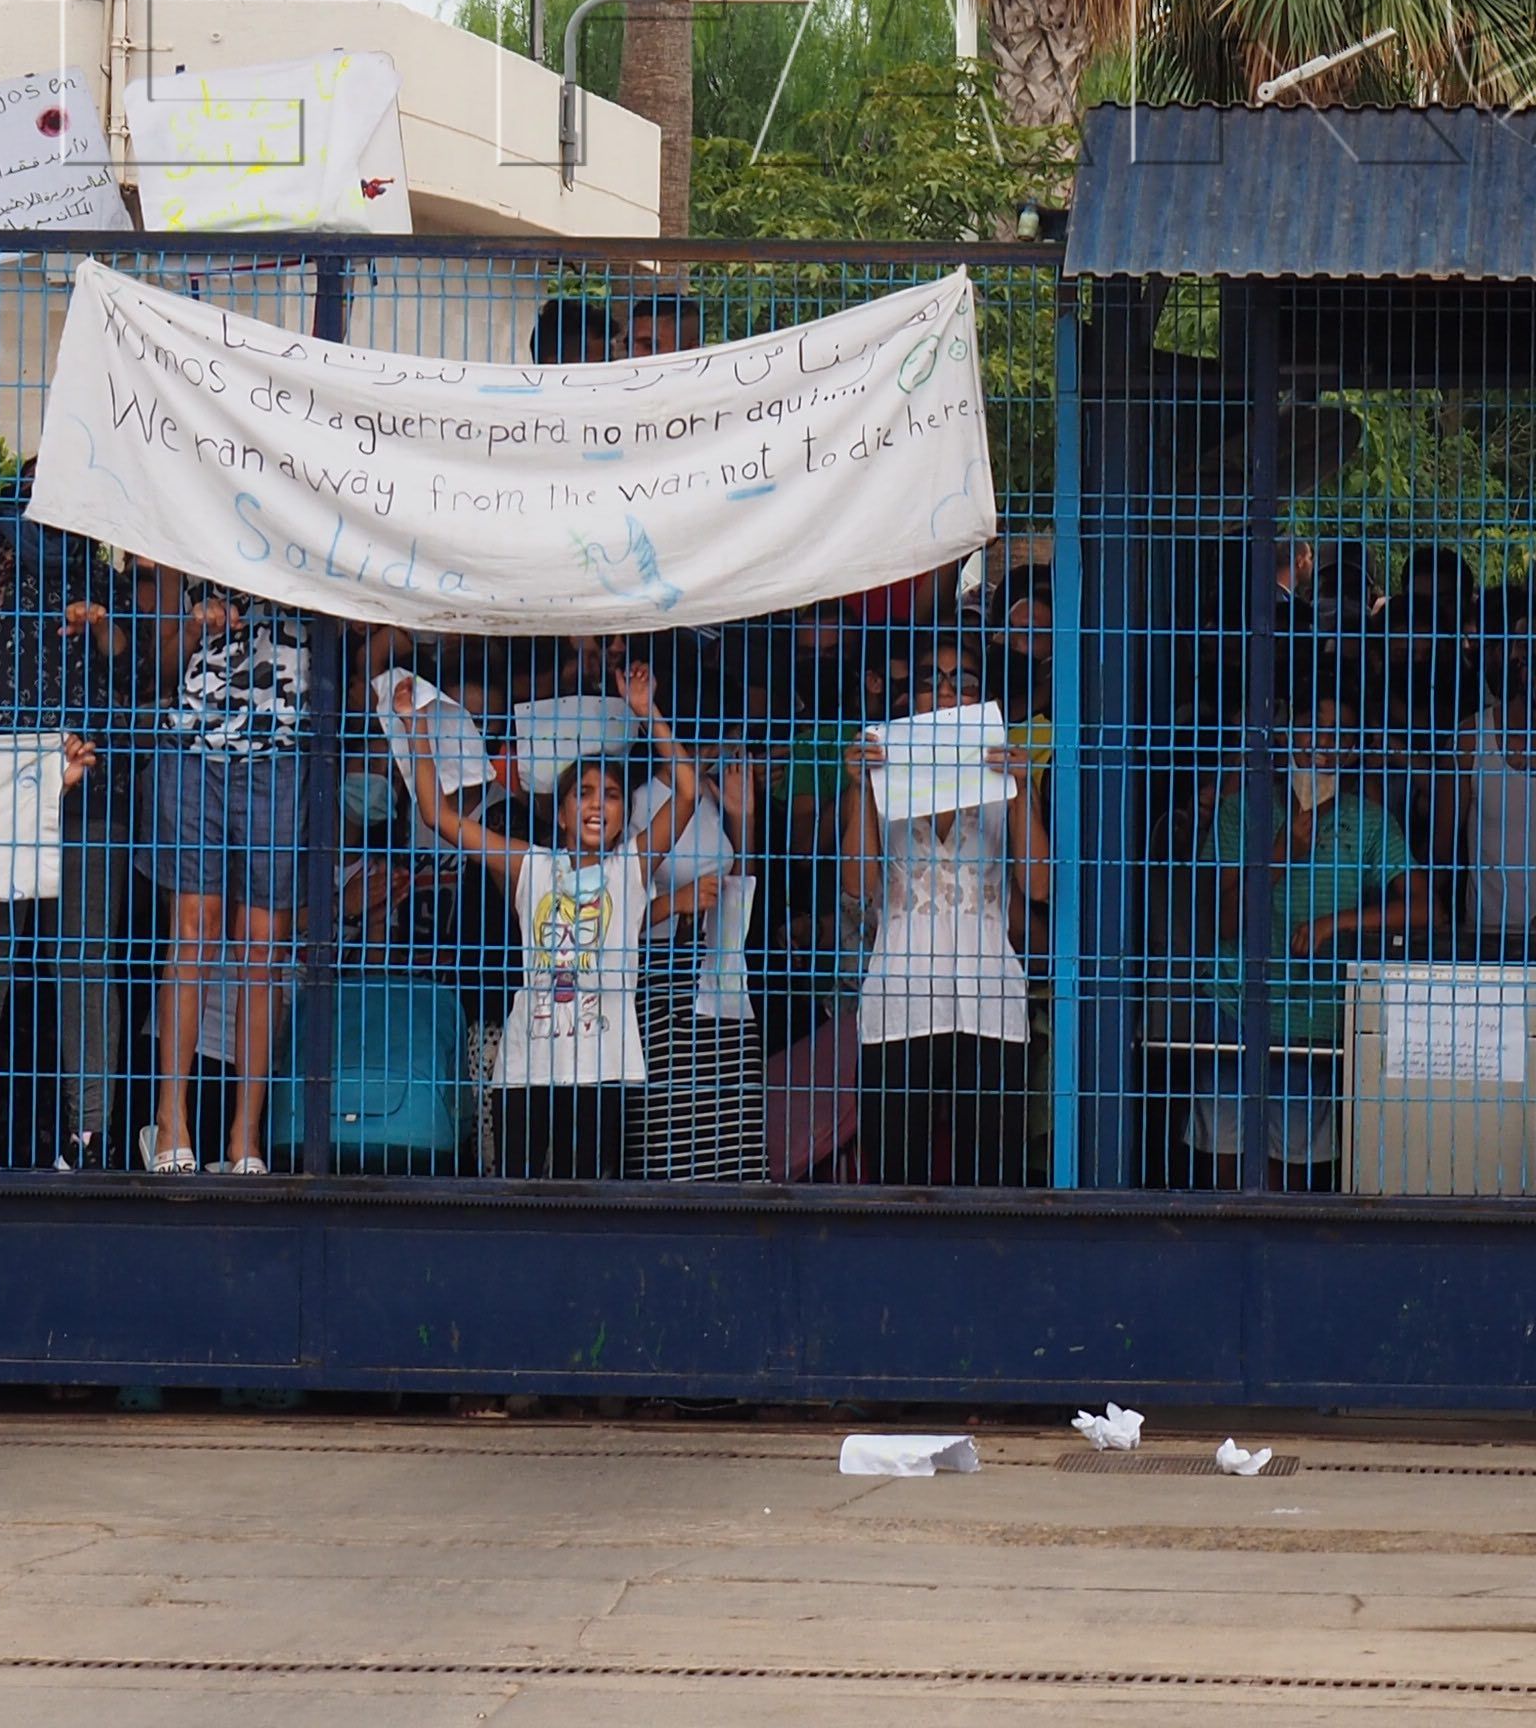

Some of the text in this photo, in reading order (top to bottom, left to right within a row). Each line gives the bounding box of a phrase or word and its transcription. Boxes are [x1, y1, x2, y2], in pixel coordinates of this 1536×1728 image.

[107, 371, 181, 453] We
[194, 436, 265, 474] ran
[279, 452, 395, 517] away
[428, 473, 526, 515] from
[549, 482, 598, 512] the
[721, 441, 775, 486] not
[801, 424, 838, 473] to
[848, 423, 895, 461] die
[250, 376, 292, 415] de
[582, 422, 622, 446] no
